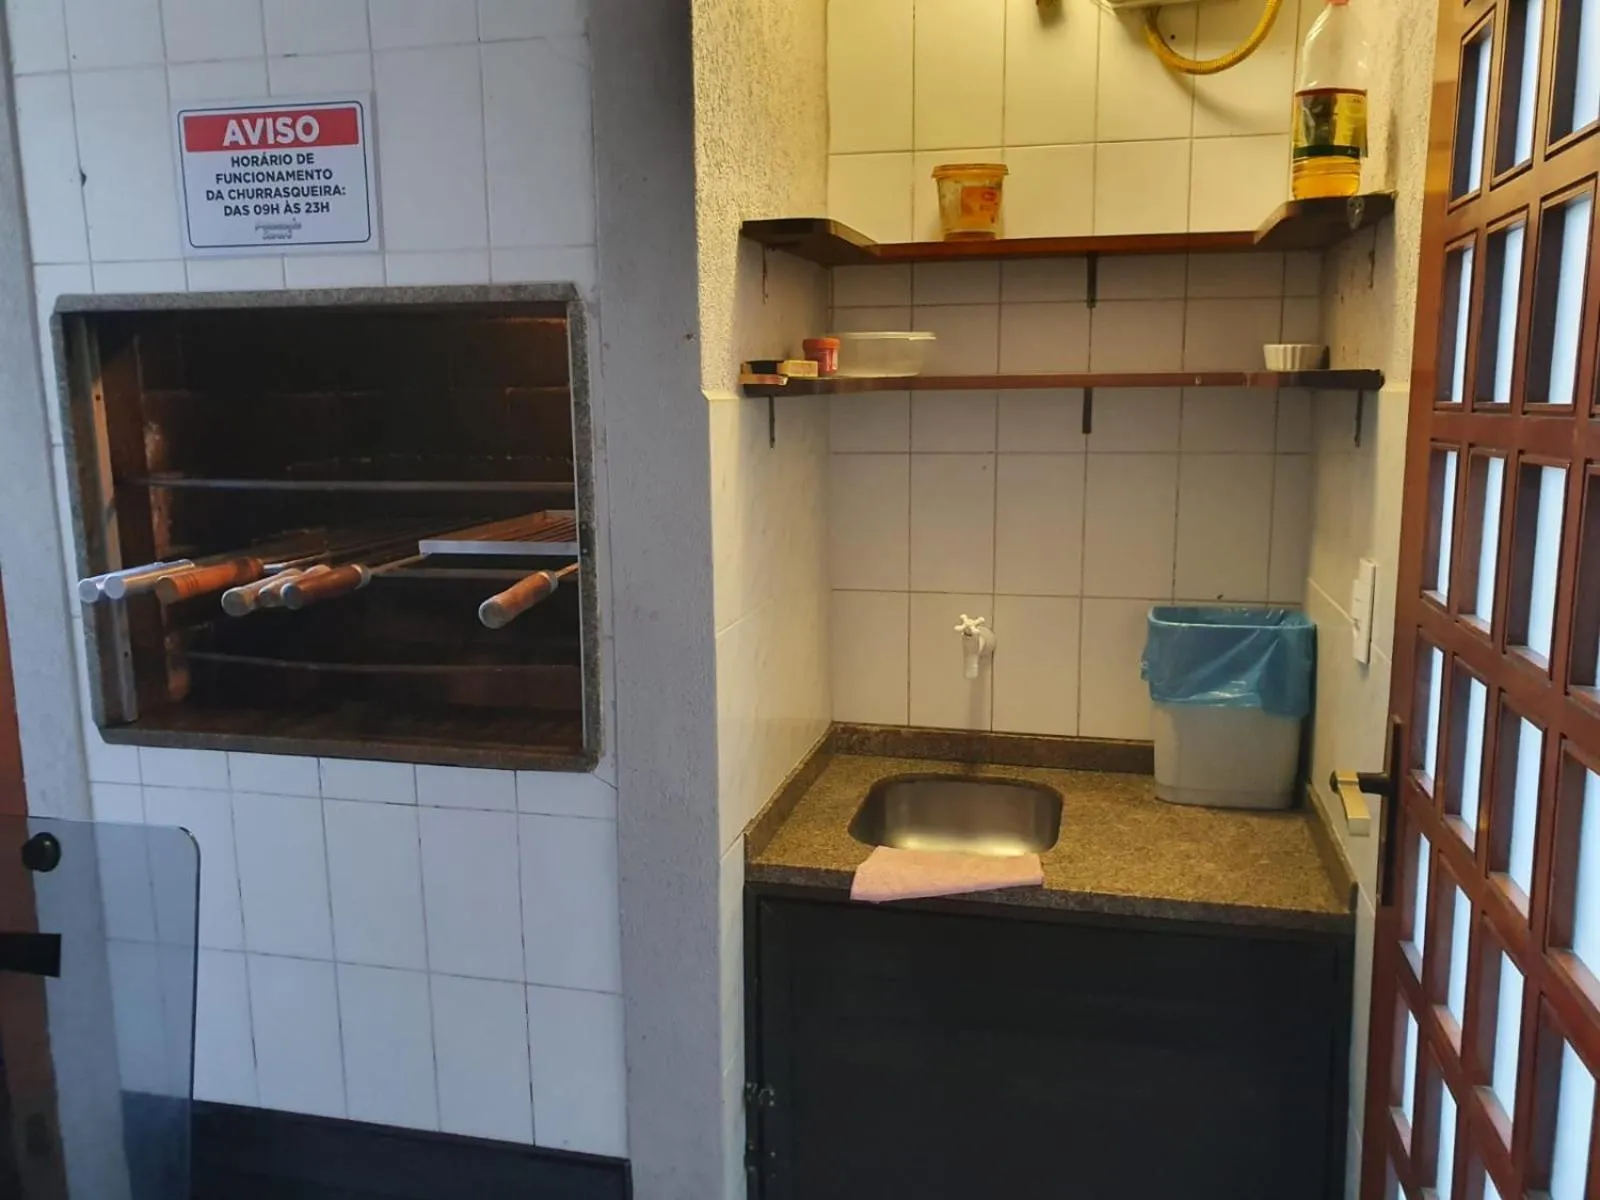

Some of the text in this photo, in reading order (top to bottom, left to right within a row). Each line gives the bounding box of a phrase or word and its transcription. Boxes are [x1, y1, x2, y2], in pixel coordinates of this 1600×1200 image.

[222, 115, 320, 147] AVISO
[231, 152, 315, 168] HORÁRIO DE
[216, 168, 333, 184] FUNCIONAMENTO
[206, 185, 346, 201] DA CHURRASQUEIRA:
[224, 200, 330, 217] DAS 09H ÀS 23H
